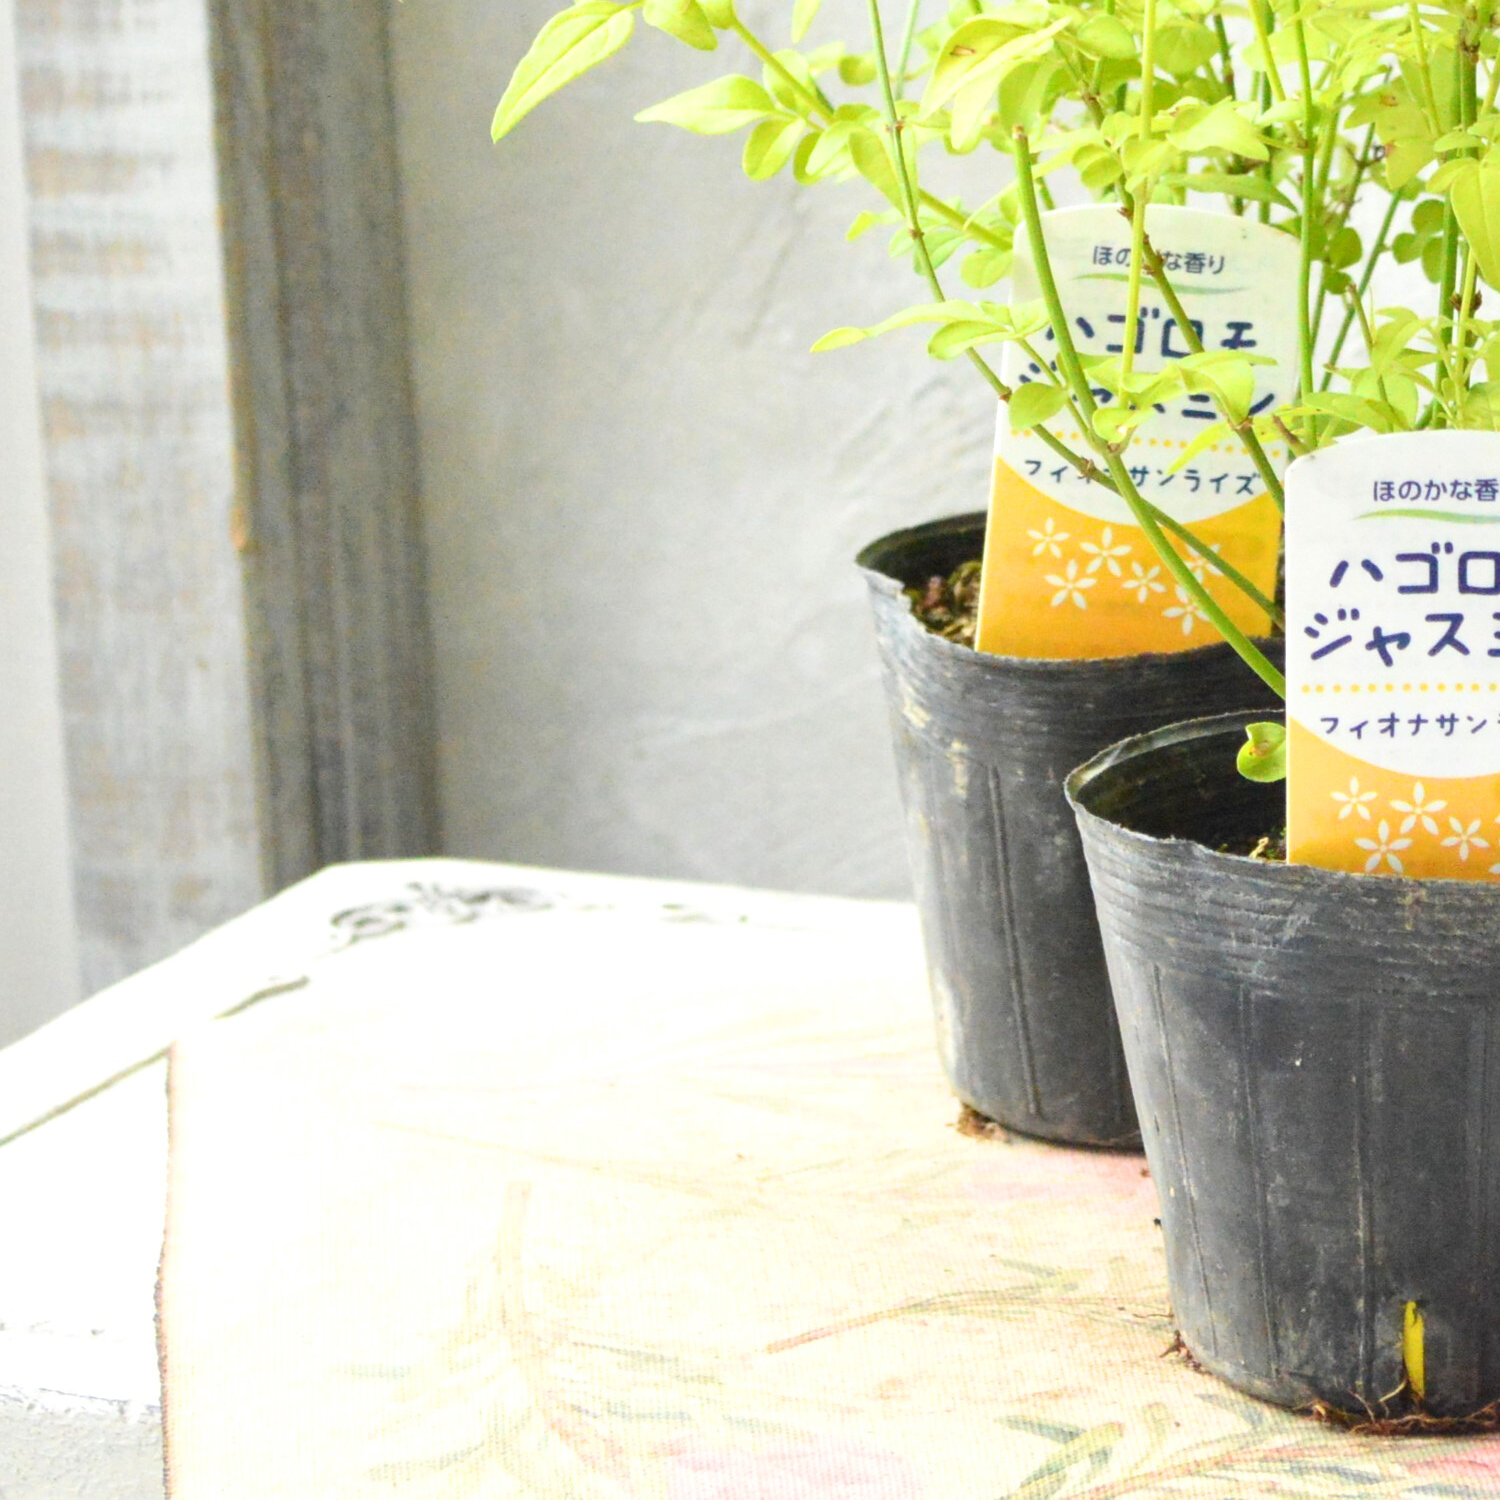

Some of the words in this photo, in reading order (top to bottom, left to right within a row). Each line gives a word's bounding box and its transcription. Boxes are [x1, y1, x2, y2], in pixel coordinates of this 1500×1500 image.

[1092, 244, 1226, 276] ほのな香り
